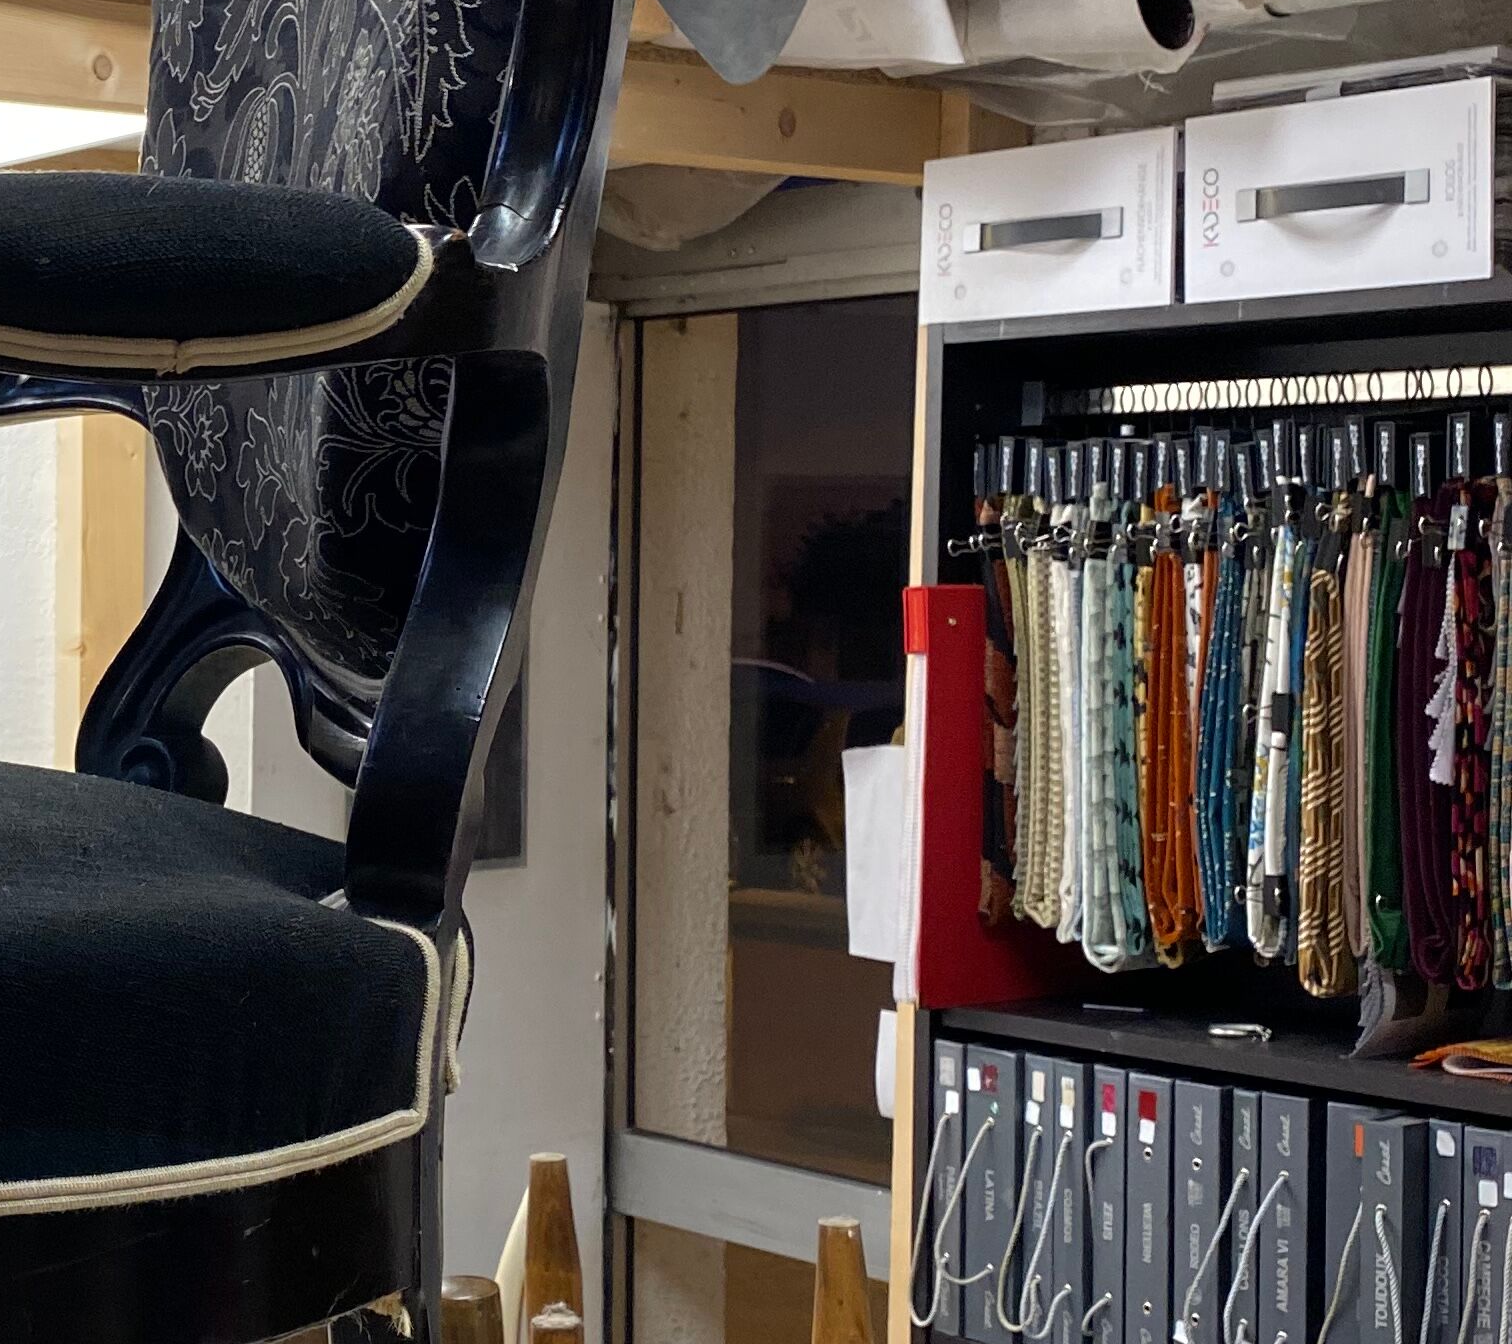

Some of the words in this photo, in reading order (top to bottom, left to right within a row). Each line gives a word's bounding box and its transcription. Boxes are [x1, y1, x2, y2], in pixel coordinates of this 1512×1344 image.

[938, 203, 953, 276] KADECO
[1202, 167, 1219, 248] KADECO
[985, 1170, 995, 1221] LATINA
[1103, 1201, 1113, 1241] ZEUS
[1142, 1202, 1152, 1263] WESTERN
[1276, 1257, 1289, 1313] AMARA
[1375, 1253, 1389, 1329] TOUDOUX
[1477, 1241, 1492, 1329] CAMPECHE
